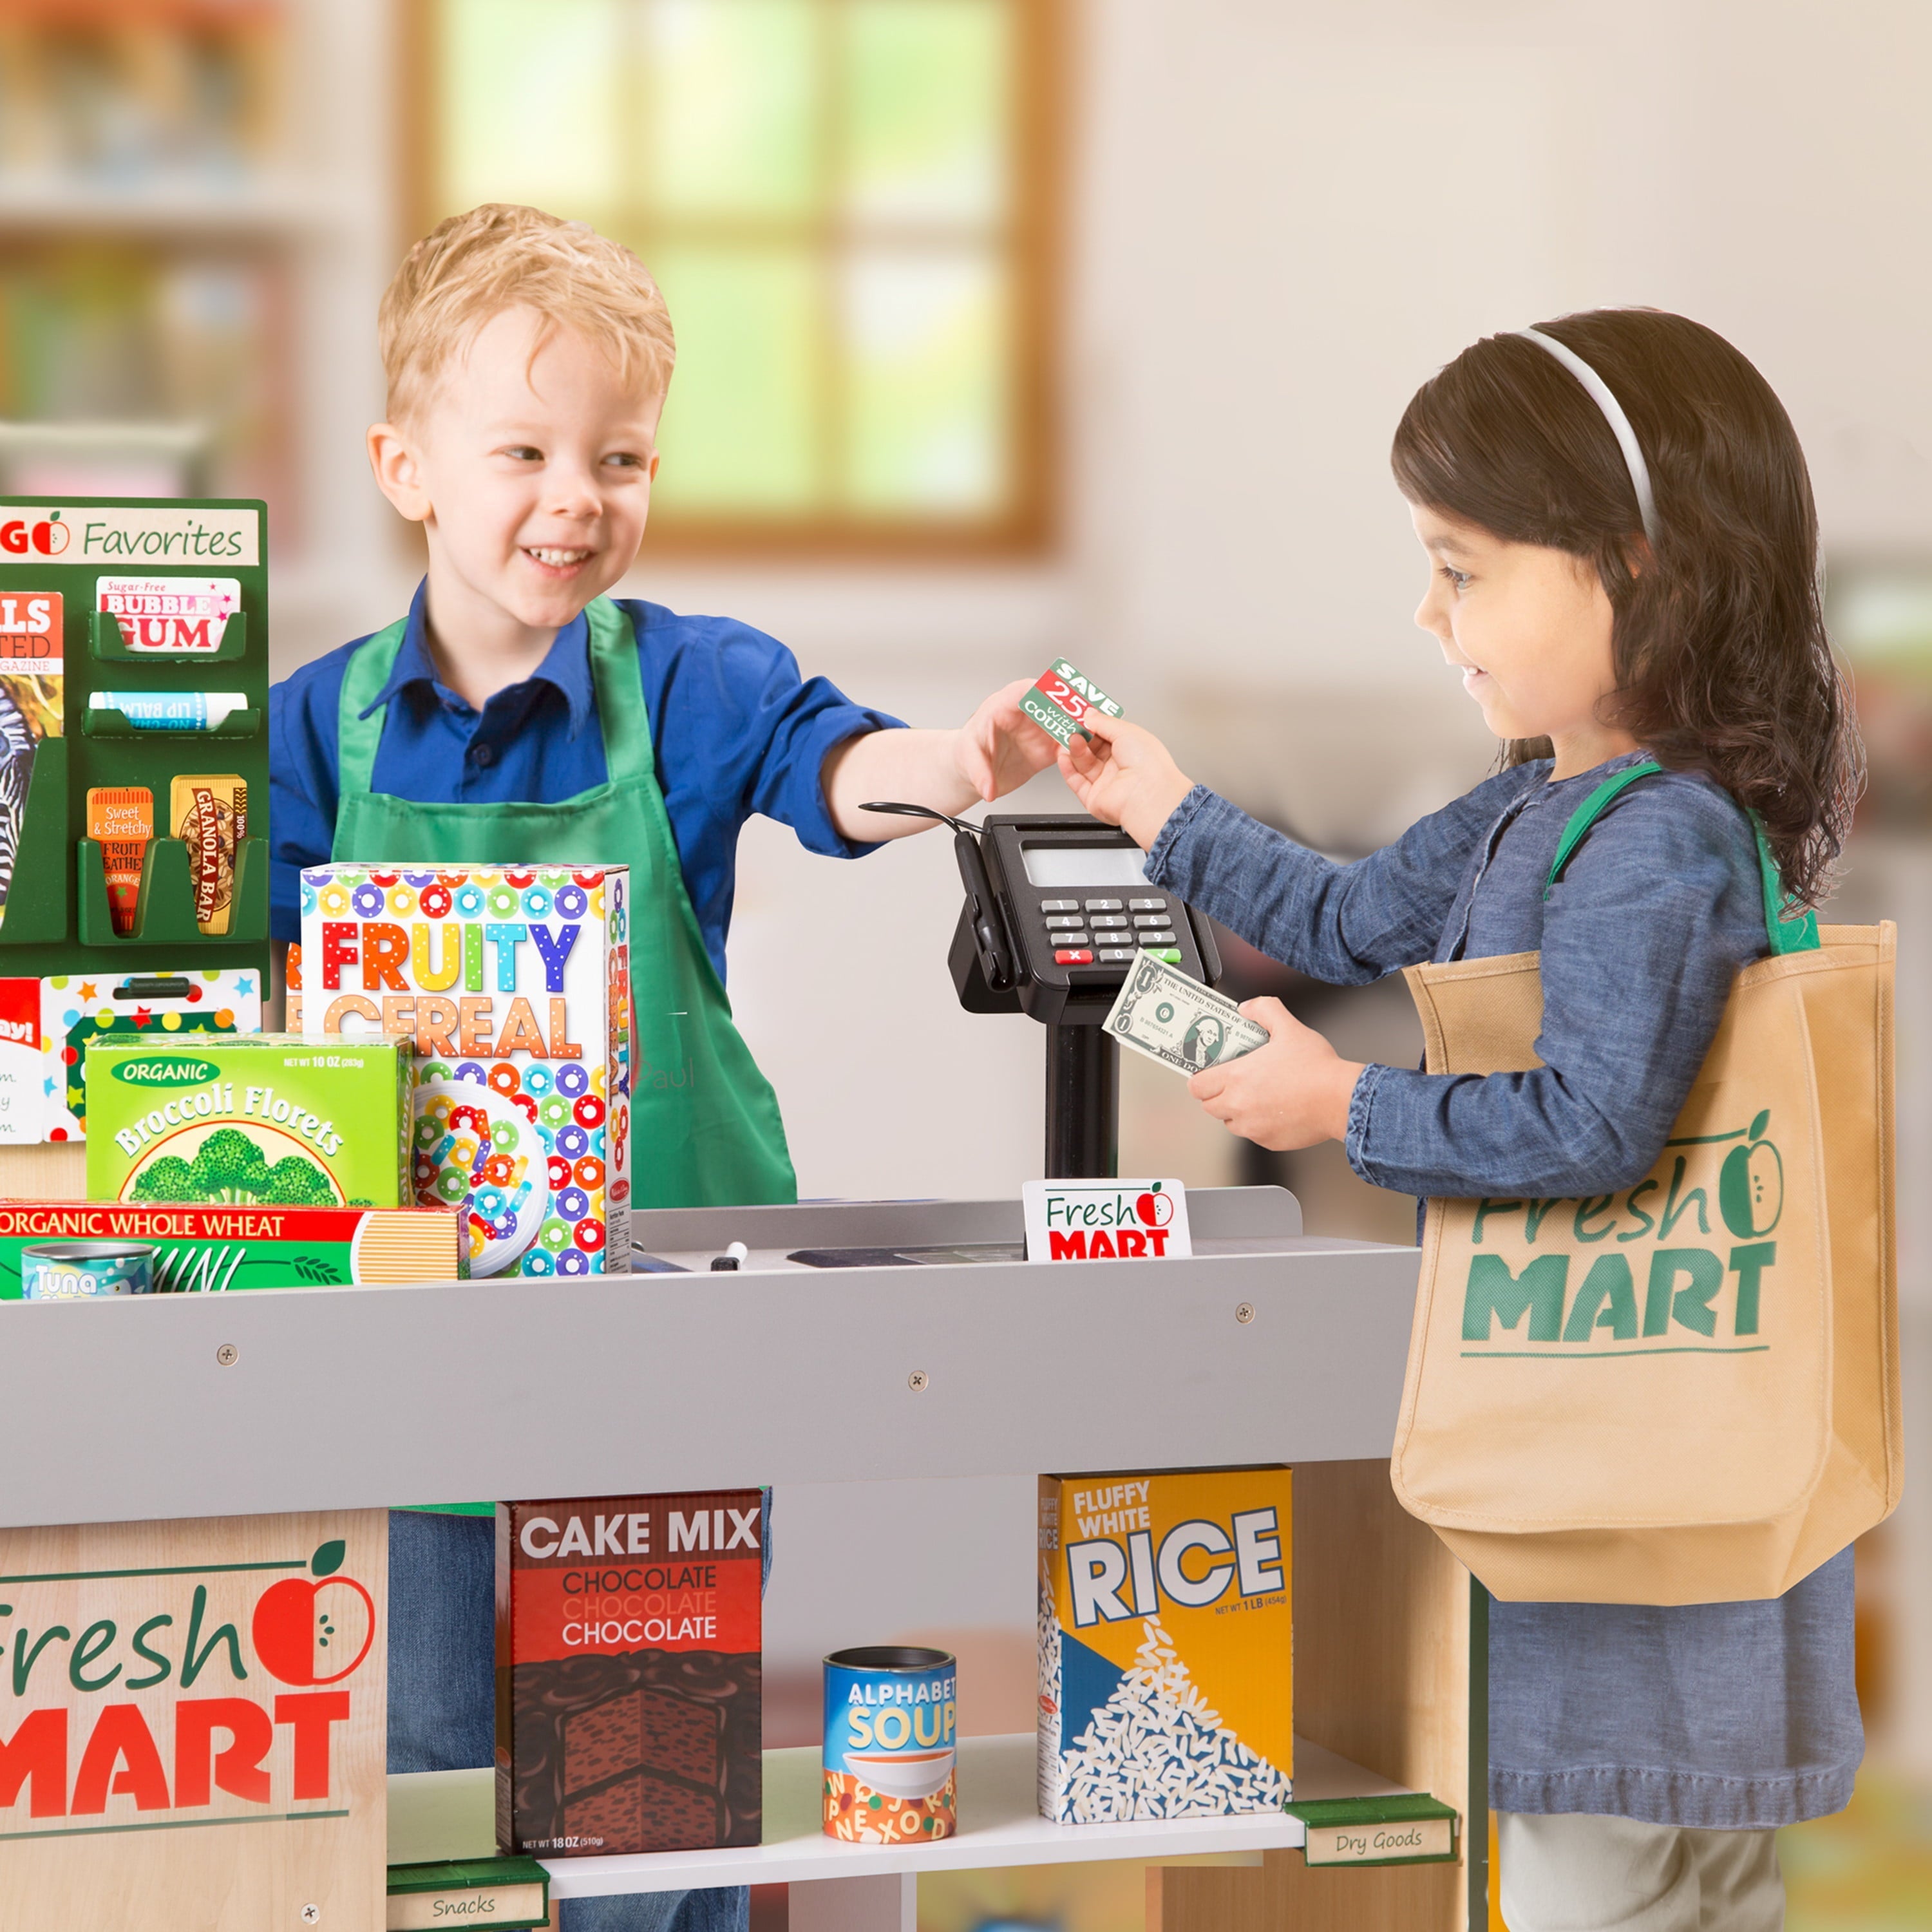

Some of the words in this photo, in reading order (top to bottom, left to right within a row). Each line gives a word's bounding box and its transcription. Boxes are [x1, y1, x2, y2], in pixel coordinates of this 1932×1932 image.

[84, 520, 242, 556] Favorites
[107, 582, 166, 592] Sugar-Free
[0, 599, 51, 634] LS
[106, 595, 211, 615] BUBBLE
[116, 617, 213, 648] GUM
[1056, 663, 1119, 717] SAVE
[167, 702, 191, 719] LIP
[1047, 706, 1076, 732] with
[106, 806, 140, 820] Sweet
[236, 815, 245, 839] 100%
[94, 822, 101, 835] &
[104, 820, 152, 838] Stretchy
[196, 791, 217, 876] GRANOLA
[104, 842, 141, 856] FRUIT
[103, 857, 144, 871] EATHE
[196, 880, 216, 922] BAR
[1057, 900, 1063, 909] 1
[1100, 900, 1108, 909] 2
[1144, 899, 1152, 909] 3
[1061, 917, 1070, 926] 4
[1106, 916, 1113, 925] 5
[1149, 916, 1157, 925] 6
[1066, 933, 1074, 943] 7
[1110, 933, 1119, 943] 8
[1153, 933, 1162, 942] 9
[322, 923, 582, 992] FRUITY
[1141, 971, 1151, 988] 1
[1161, 1009, 1168, 1018] C
[1164, 978, 1178, 990] THE
[1179, 987, 1205, 1005] UNITED
[1204, 999, 1231, 1019] STATES
[1231, 1014, 1242, 1024] OF
[324, 995, 582, 1059] CEREAL
[609, 948, 620, 1106] CEREAL
[618, 945, 630, 1100] FRUITY
[1119, 1018, 1127, 1030] 1
[123, 1063, 208, 1081] ORGANIC
[283, 1058, 298, 1067] NET
[299, 1058, 310, 1067] WT
[312, 1056, 325, 1067] 10
[327, 1056, 340, 1067] OZ
[1161, 1051, 1182, 1066] ONE
[1183, 1062, 1199, 1074] DO
[115, 1083, 233, 1159] Broccoli
[245, 1086, 344, 1157] Florets
[0, 1212, 104, 1236] ORGANIC
[109, 1214, 196, 1236] WHOLE
[202, 1216, 285, 1237] WHEAT
[1047, 1194, 1137, 1227] Fresh
[1048, 1229, 1170, 1260] MART
[35, 1265, 97, 1294] Tuna
[1461, 1241, 1777, 1342] MART
[1073, 1481, 1150, 1515] FLUFFY
[520, 1513, 650, 1559] CAKE
[668, 1508, 761, 1553] MIX
[1077, 1506, 1150, 1539] WHITE
[562, 1566, 717, 1595] CHOCOLATE
[1066, 1506, 1285, 1629] RICE
[562, 1592, 717, 1620] CHOCOLATE
[1215, 1606, 1228, 1615] NET
[1230, 1603, 1242, 1613] WT
[1244, 1600, 1249, 1611] 1
[1251, 1598, 1264, 1610] LB
[1265, 1595, 1287, 1607] (454g)
[562, 1616, 717, 1645] CHOCOLATE
[848, 1677, 956, 1705] ALPHABET
[848, 1702, 956, 1749] SOUP
[522, 1841, 536, 1849] NET
[538, 1840, 549, 1848] WT
[552, 1837, 564, 1849] 18
[565, 1836, 579, 1848] OZ
[580, 1837, 603, 1847] (510g)
[1336, 1836, 1367, 1855] Dry
[1373, 1828, 1423, 1849] Goods
[433, 1895, 495, 1917] Snacks
